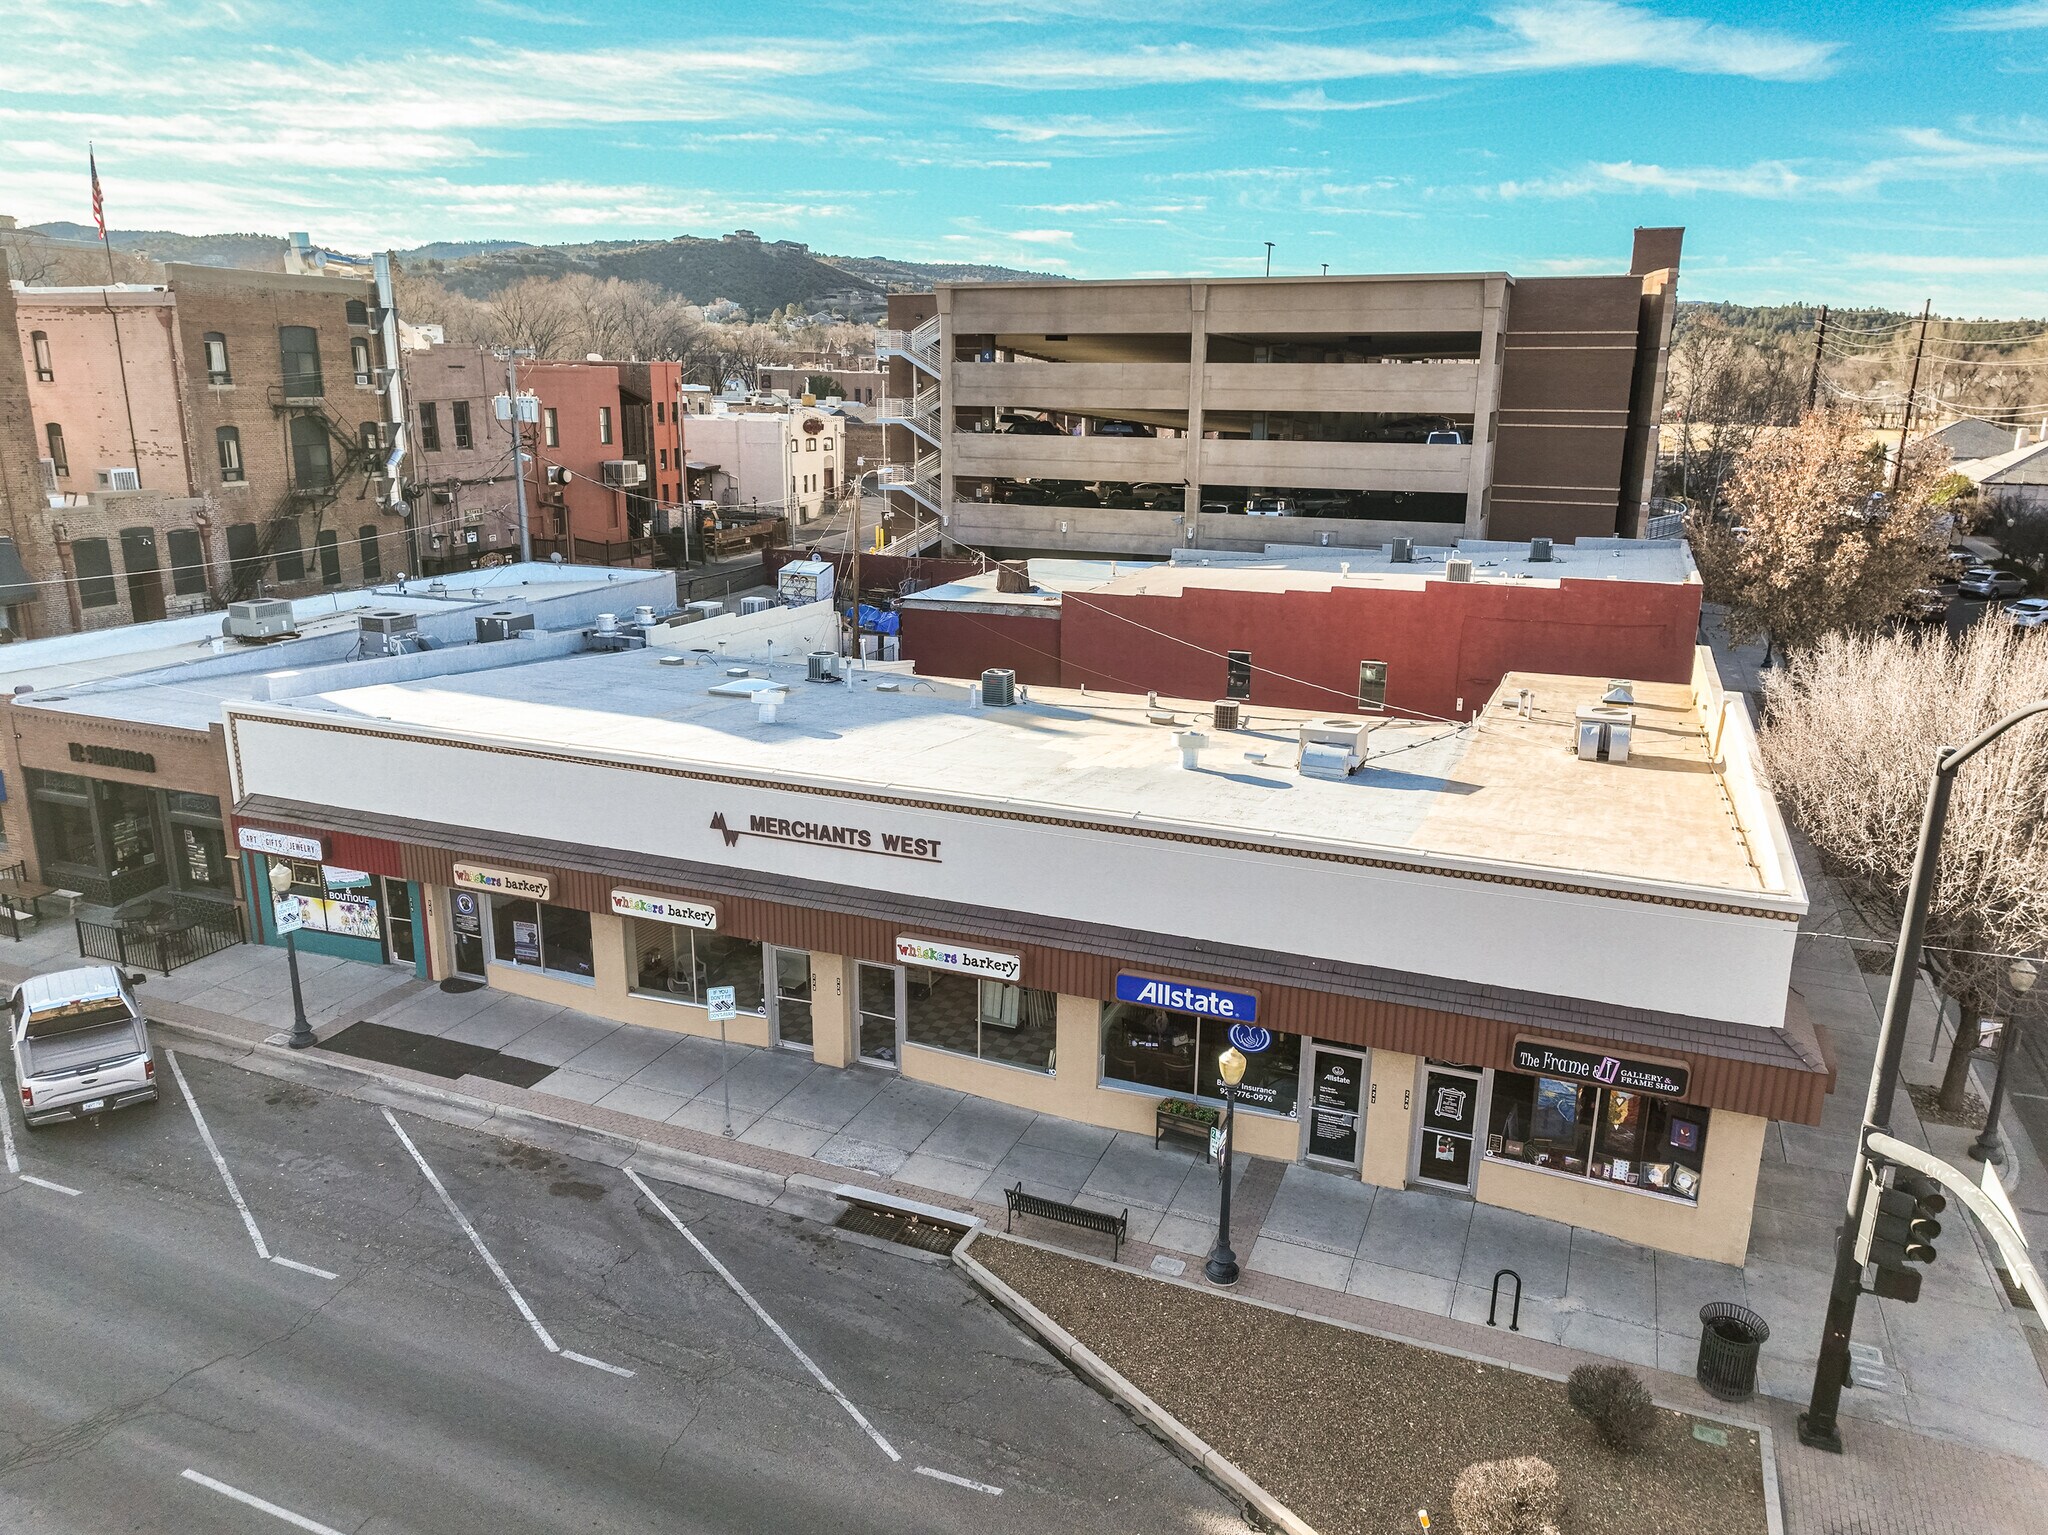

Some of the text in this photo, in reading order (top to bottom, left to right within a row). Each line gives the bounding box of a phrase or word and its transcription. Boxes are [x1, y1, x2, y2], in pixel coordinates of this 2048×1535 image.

[246, 835, 315, 854] ART GIFTS JEWELRY
[750, 815, 942, 858] MERCHANTS WEST
[455, 870, 548, 898] whiskers barkery
[329, 891, 370, 904] BOUTIQUE
[613, 896, 715, 927] whiskers barkery
[897, 944, 1018, 978] whiskers barkery
[1137, 982, 1234, 1016] Allstate
[1520, 1052, 1540, 1067] The
[1542, 1052, 1590, 1076] Frame
[1593, 1065, 1600, 1079] &
[1324, 1074, 1351, 1085] Allstate
[1621, 1069, 1672, 1085] GALLERY &
[1621, 1077, 1680, 1093] FRAME SHOP
[1220, 1087, 1273, 1103] 92-776-0976
[1241, 1082, 1277, 1096] Insurance
